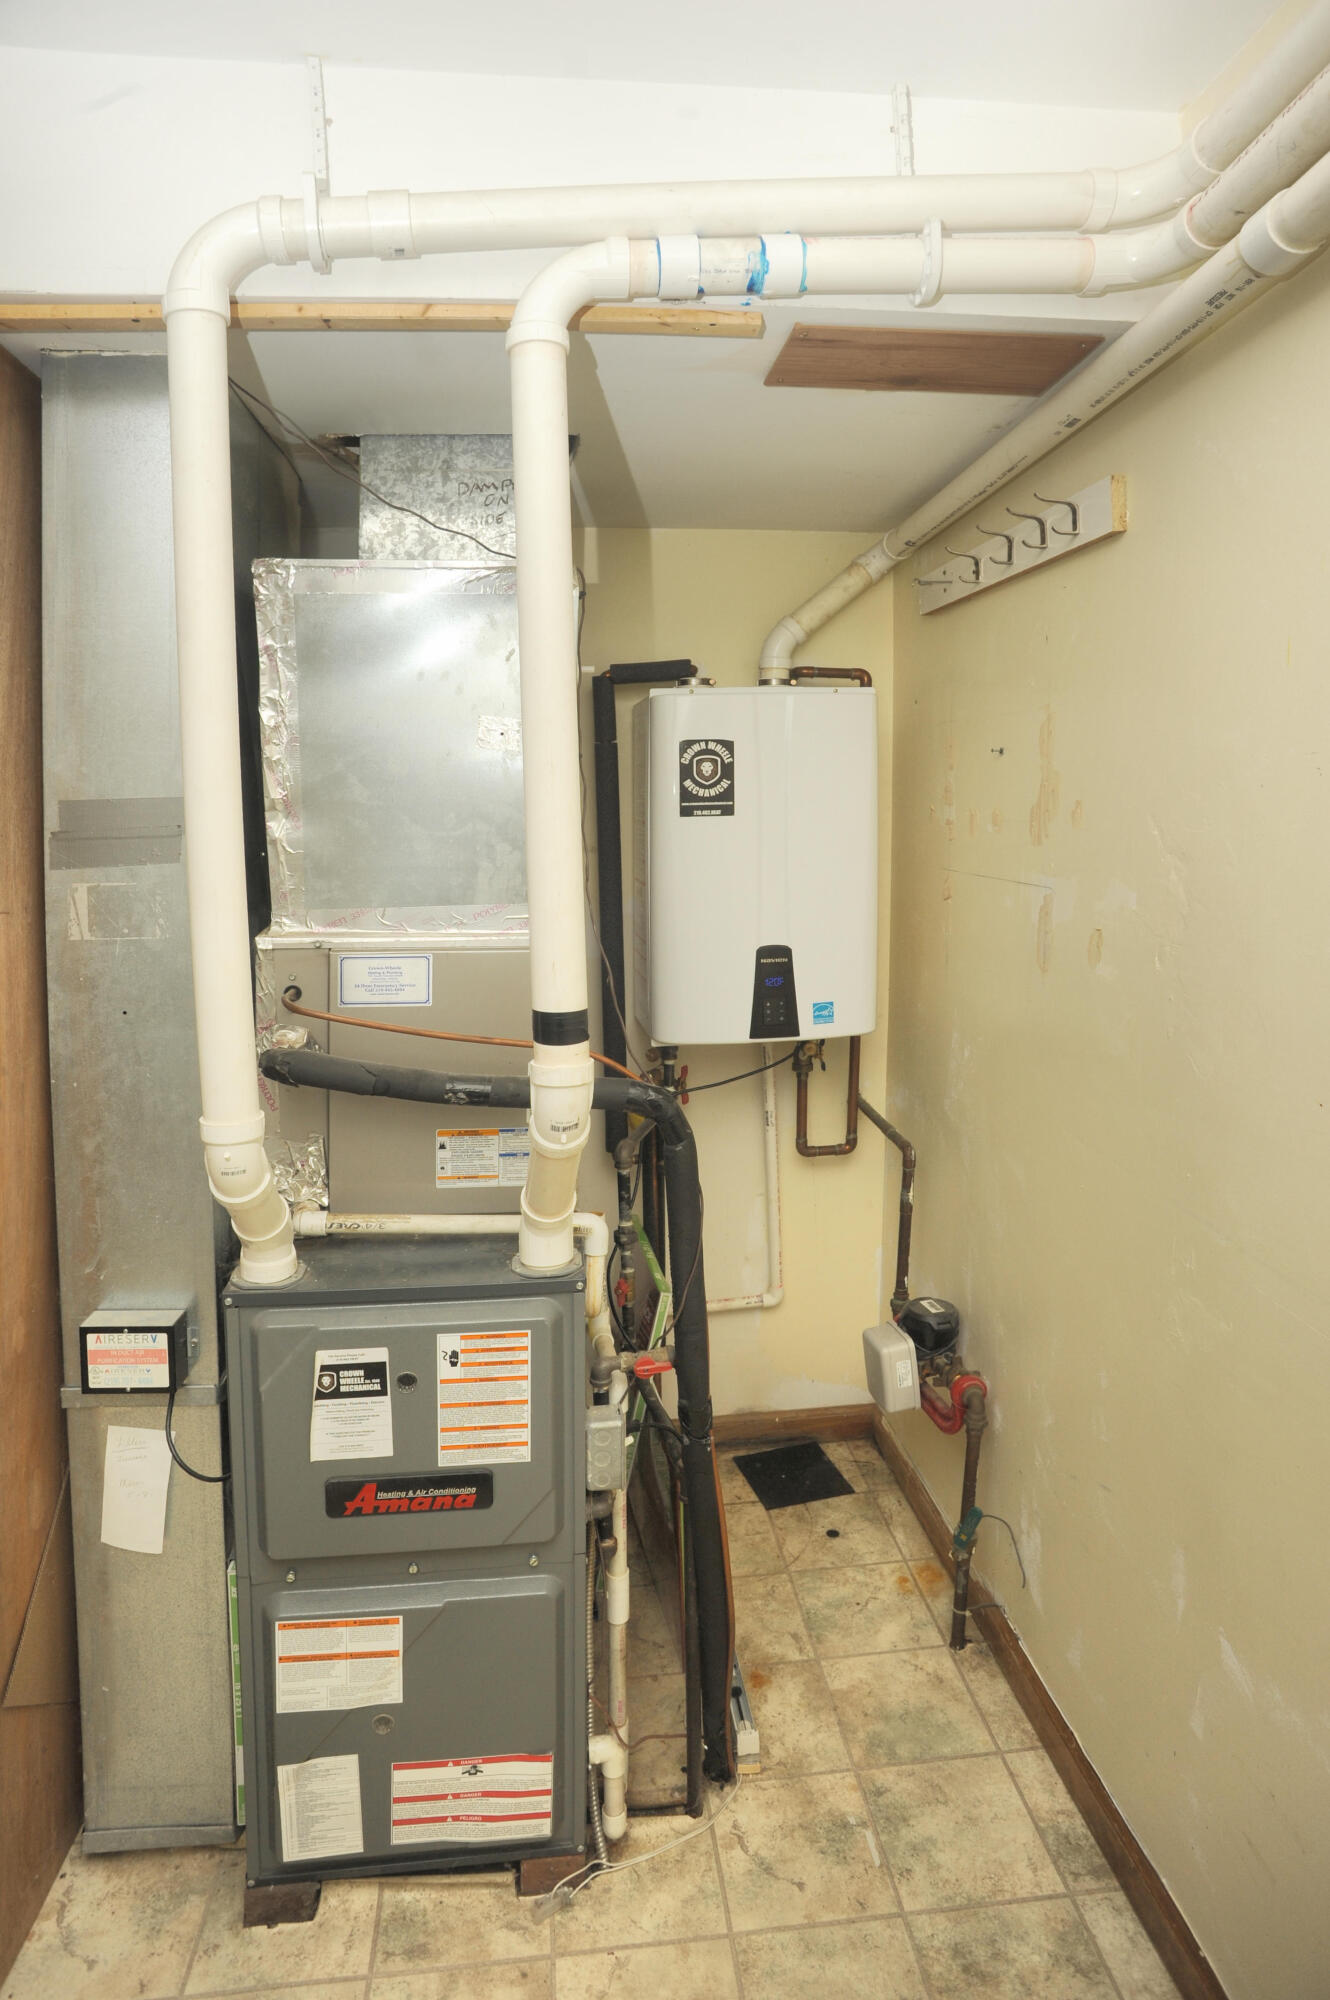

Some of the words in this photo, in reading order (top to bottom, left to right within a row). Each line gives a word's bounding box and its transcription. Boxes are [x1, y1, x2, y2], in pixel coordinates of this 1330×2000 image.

[457, 478, 515, 497] DAMP
[681, 741, 707, 765] CROWN
[683, 778, 732, 798] MECHANICAL
[95, 1334, 158, 1345] AIRESERV
[339, 1369, 364, 1378] CROWN
[340, 1383, 382, 1392] MECHANICAL
[343, 1482, 478, 1516] Amana
[377, 1490, 406, 1499] Heating
[428, 1486, 477, 1496] Conditioning
